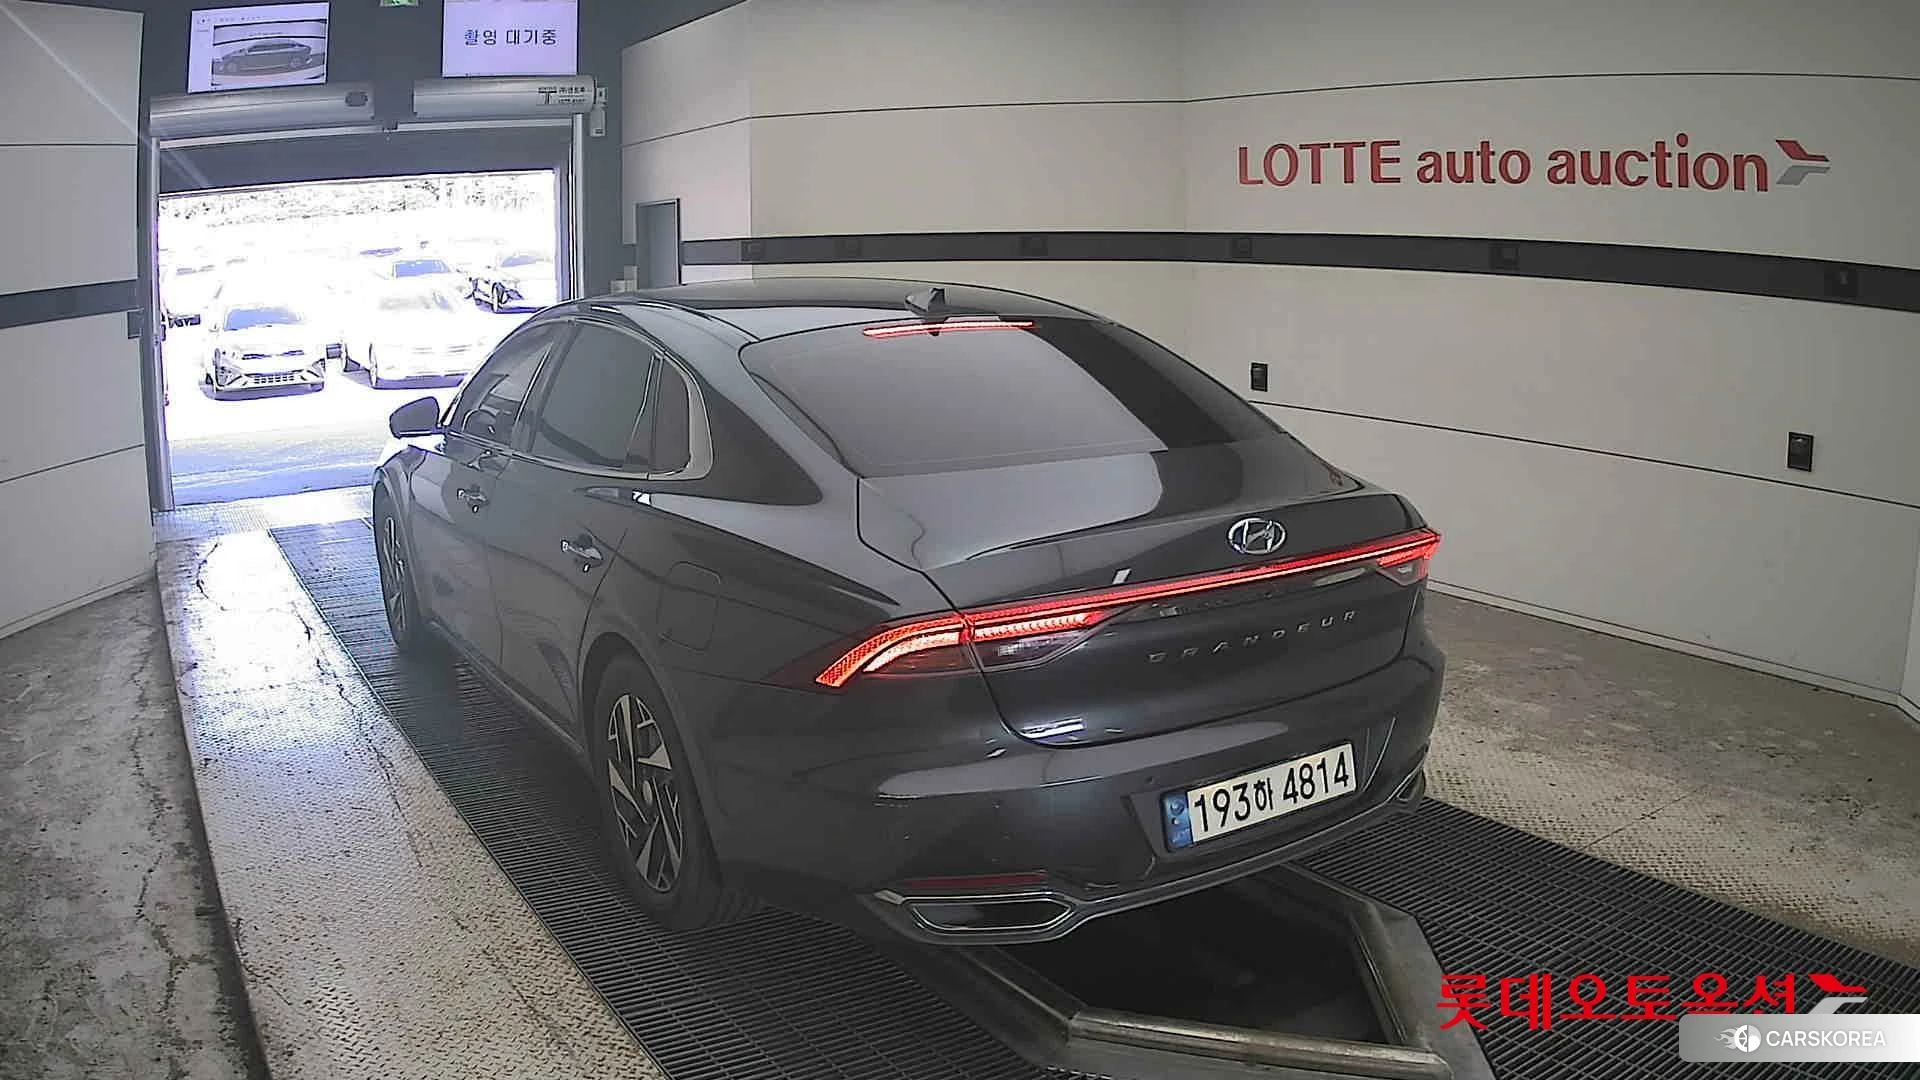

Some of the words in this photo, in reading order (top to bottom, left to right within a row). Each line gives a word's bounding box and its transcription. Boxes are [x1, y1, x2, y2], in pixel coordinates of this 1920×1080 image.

[464, 29, 497, 46] 촬영
[506, 29, 557, 46] 대기중
[1237, 139, 1401, 187] LOTTE
[1416, 139, 1532, 185] auto
[1546, 132, 1769, 193] auction
[1194, 777, 1274, 833] 193하
[1282, 751, 1350, 805] 4814
